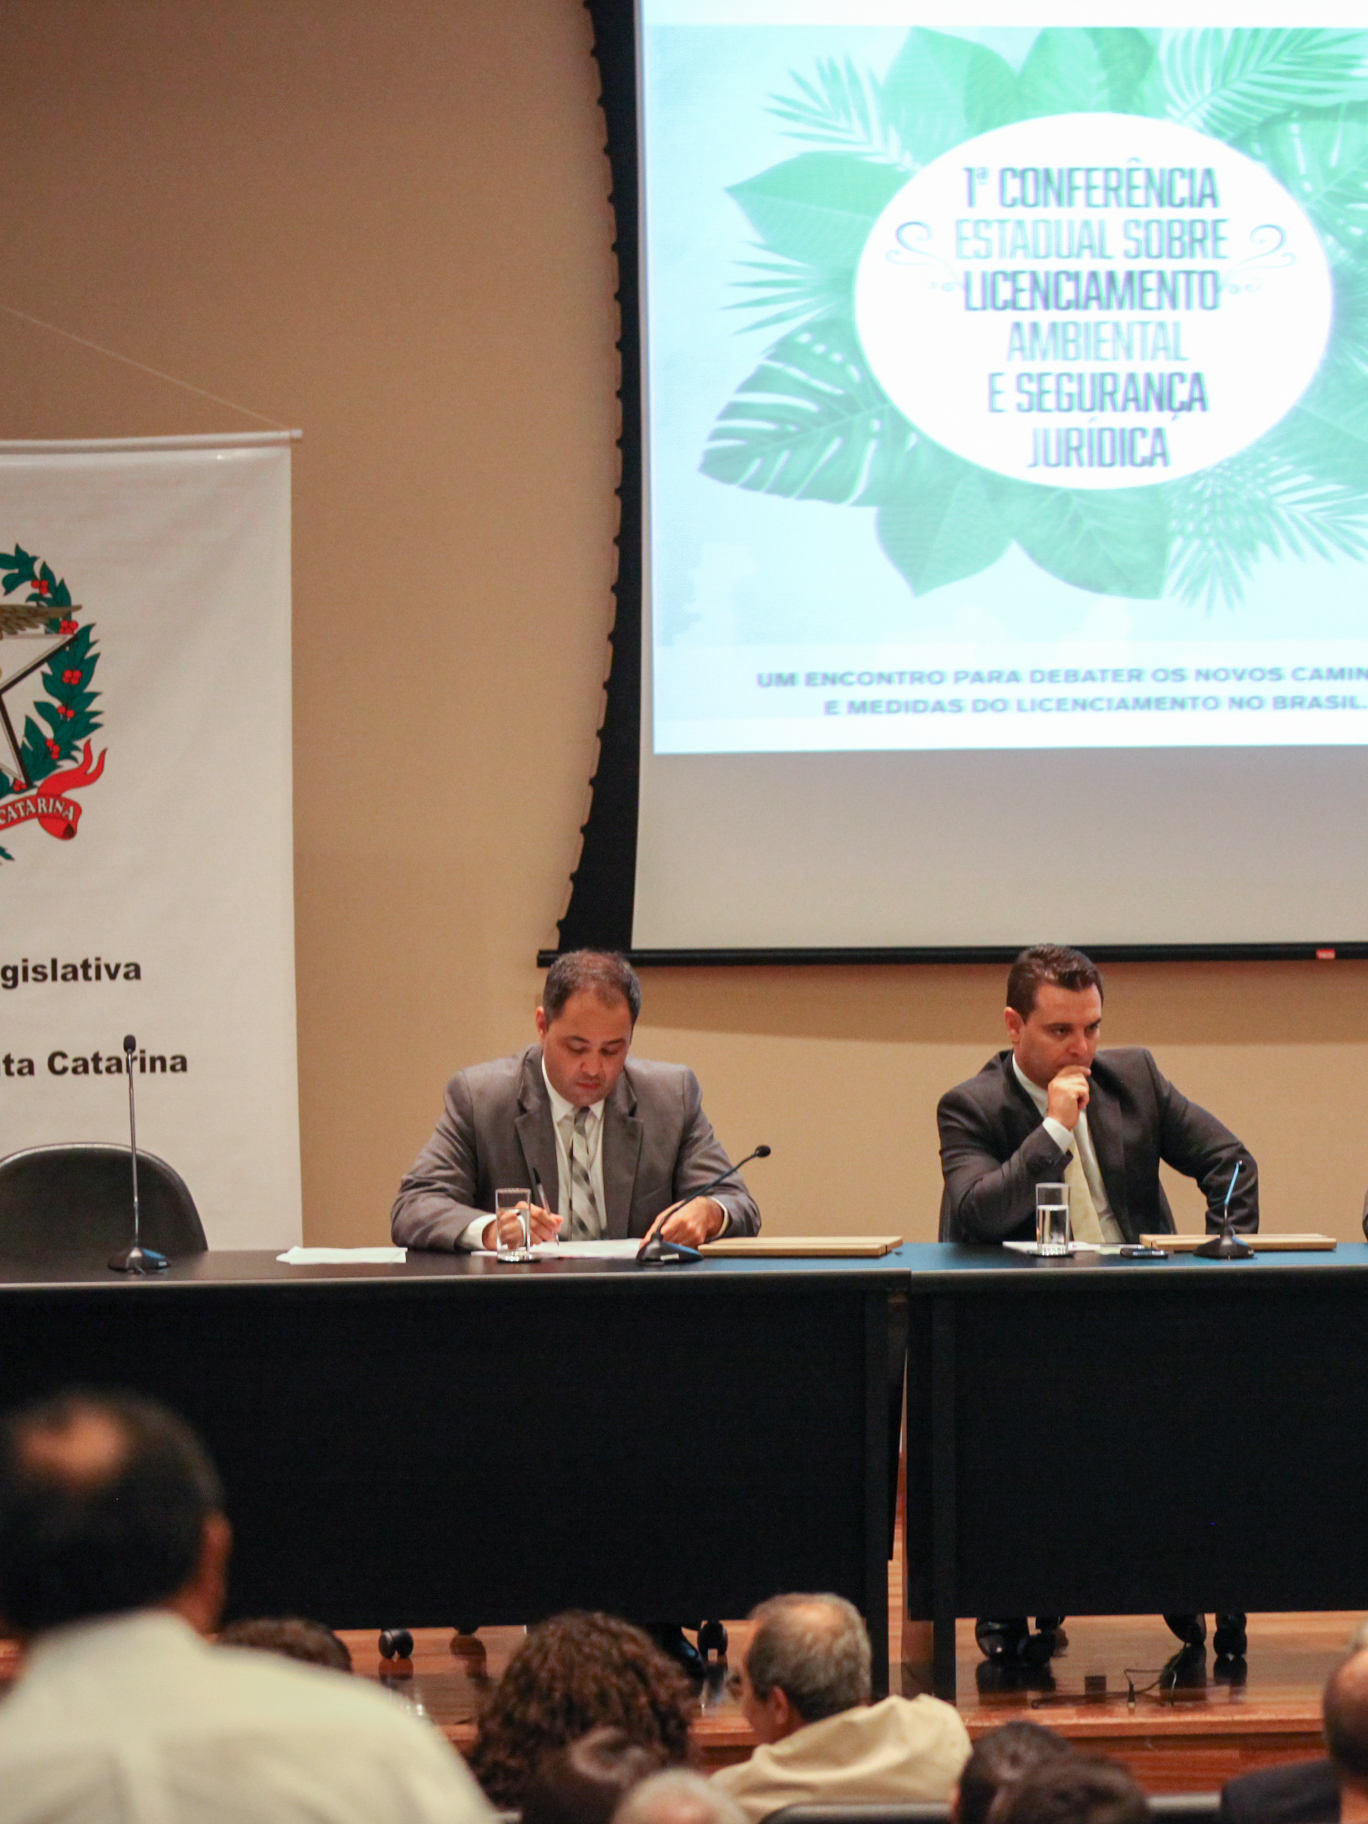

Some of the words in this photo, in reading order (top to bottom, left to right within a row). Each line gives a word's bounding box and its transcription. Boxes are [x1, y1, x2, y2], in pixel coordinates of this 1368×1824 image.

[999, 156, 1220, 208] CONFERÊNCIA
[955, 218, 1115, 260] ESTADUAL
[1122, 218, 1230, 260] SOBRE
[964, 269, 1221, 311] LICENCIAMENTO
[1007, 320, 1190, 362] AMBIENTAL
[987, 372, 1007, 413] E
[1015, 371, 1209, 422] SEGURANÇA
[1026, 416, 1171, 468] JURÍDICA
[757, 672, 797, 688] UM
[804, 671, 944, 687] ENCONTRO
[954, 670, 1020, 685] PARA
[1030, 668, 1143, 684] DEBATER
[1151, 668, 1187, 683] OS
[1195, 667, 1284, 683] NOVOS
[824, 700, 840, 716] E
[847, 698, 964, 714] MEDIDAS
[972, 698, 1008, 713] DO
[1017, 697, 1220, 713] LICENCIAMENTO
[1228, 696, 1263, 711] NO
[1273, 695, 1368, 711] BRASIL.
[0, 797, 74, 825] CATARINA
[47, 1049, 188, 1075] Catarina
